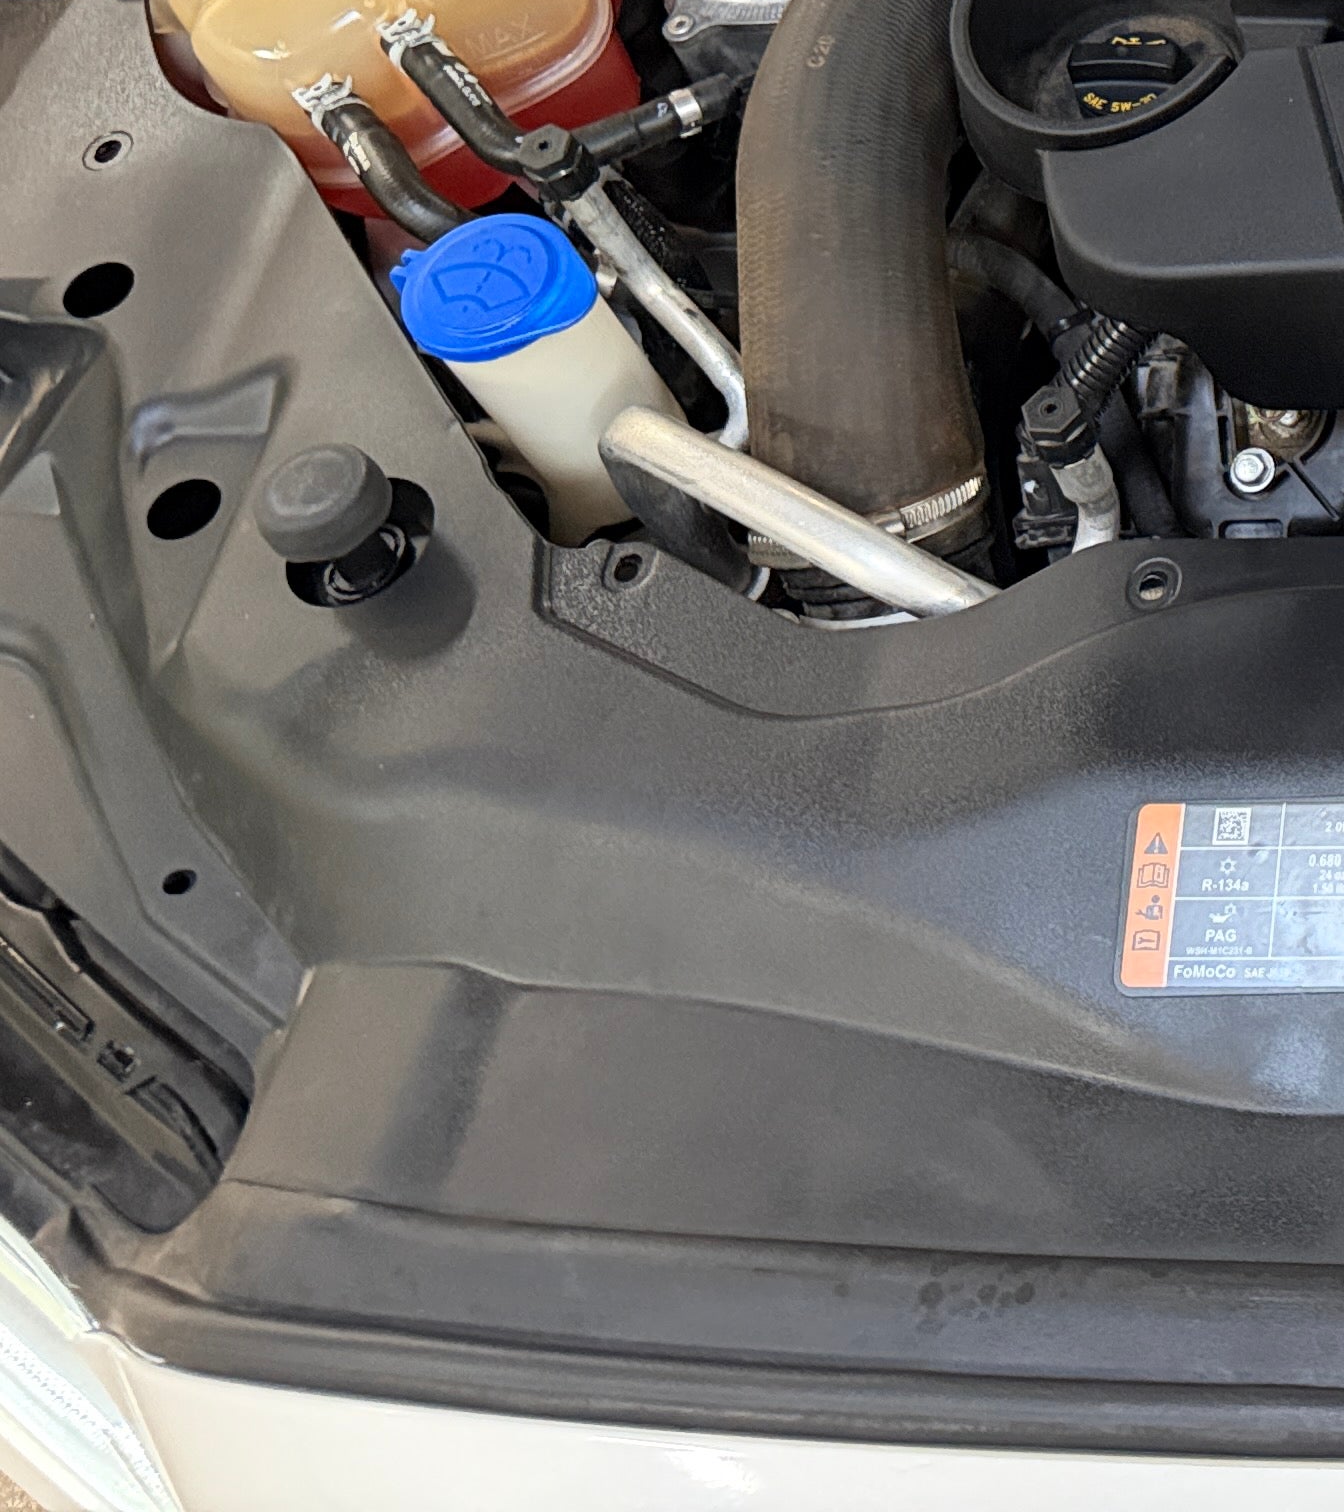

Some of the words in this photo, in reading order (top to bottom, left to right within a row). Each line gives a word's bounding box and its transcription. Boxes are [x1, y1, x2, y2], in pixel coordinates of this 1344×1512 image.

[1201, 878, 1249, 892] R-134a
[1205, 929, 1238, 943] PAG
[1174, 964, 1237, 980] FoMoCo
